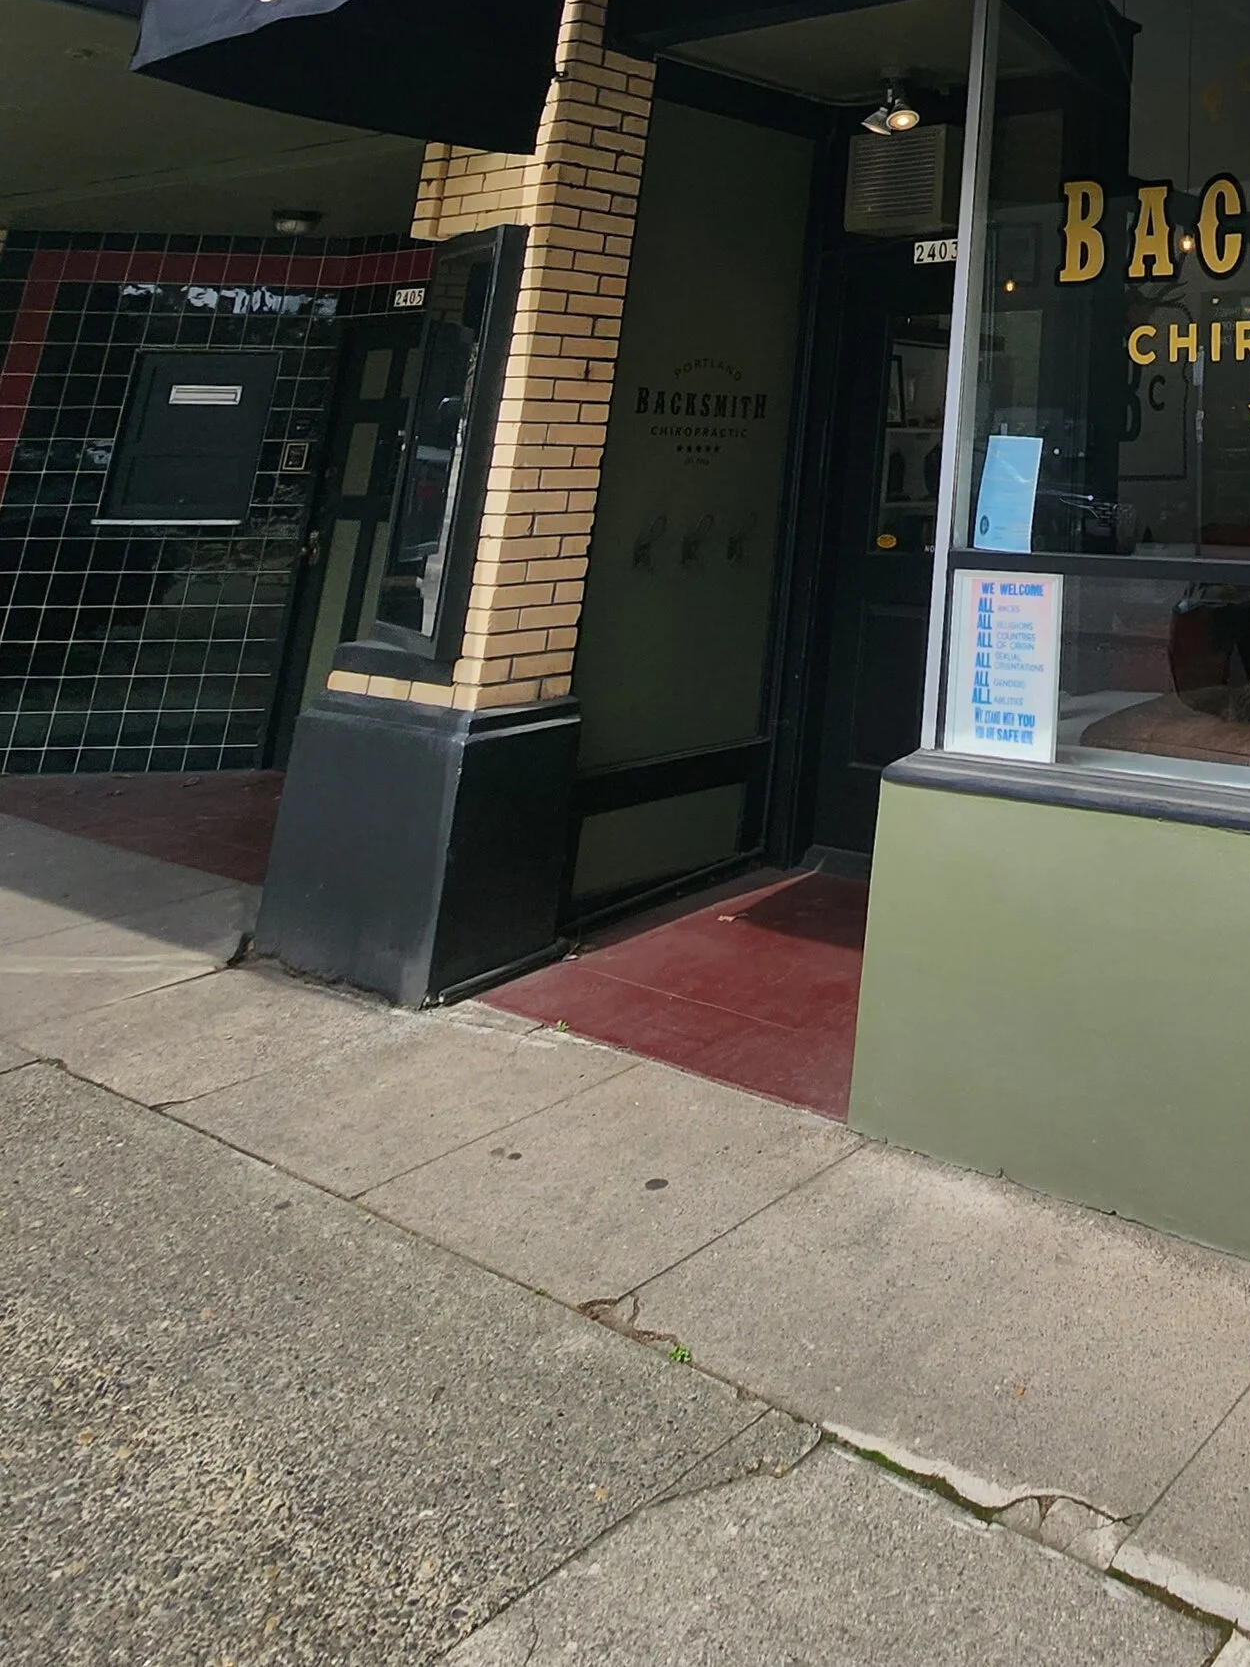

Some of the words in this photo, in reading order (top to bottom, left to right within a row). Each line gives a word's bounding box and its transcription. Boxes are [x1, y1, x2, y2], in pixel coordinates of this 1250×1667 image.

[395, 290, 423, 305] 2405
[634, 386, 768, 420] BACKSMITH
[981, 581, 996, 596] WE
[1000, 581, 1045, 597] WELCOME
[978, 597, 994, 613] ALL
[977, 614, 993, 631] ALL
[977, 631, 993, 649] ALL
[975, 652, 992, 669] ALL
[974, 670, 990, 687] ALL
[972, 687, 992, 705] ALL
[1018, 713, 1036, 729] YOU
[997, 728, 1019, 743] SAFE
